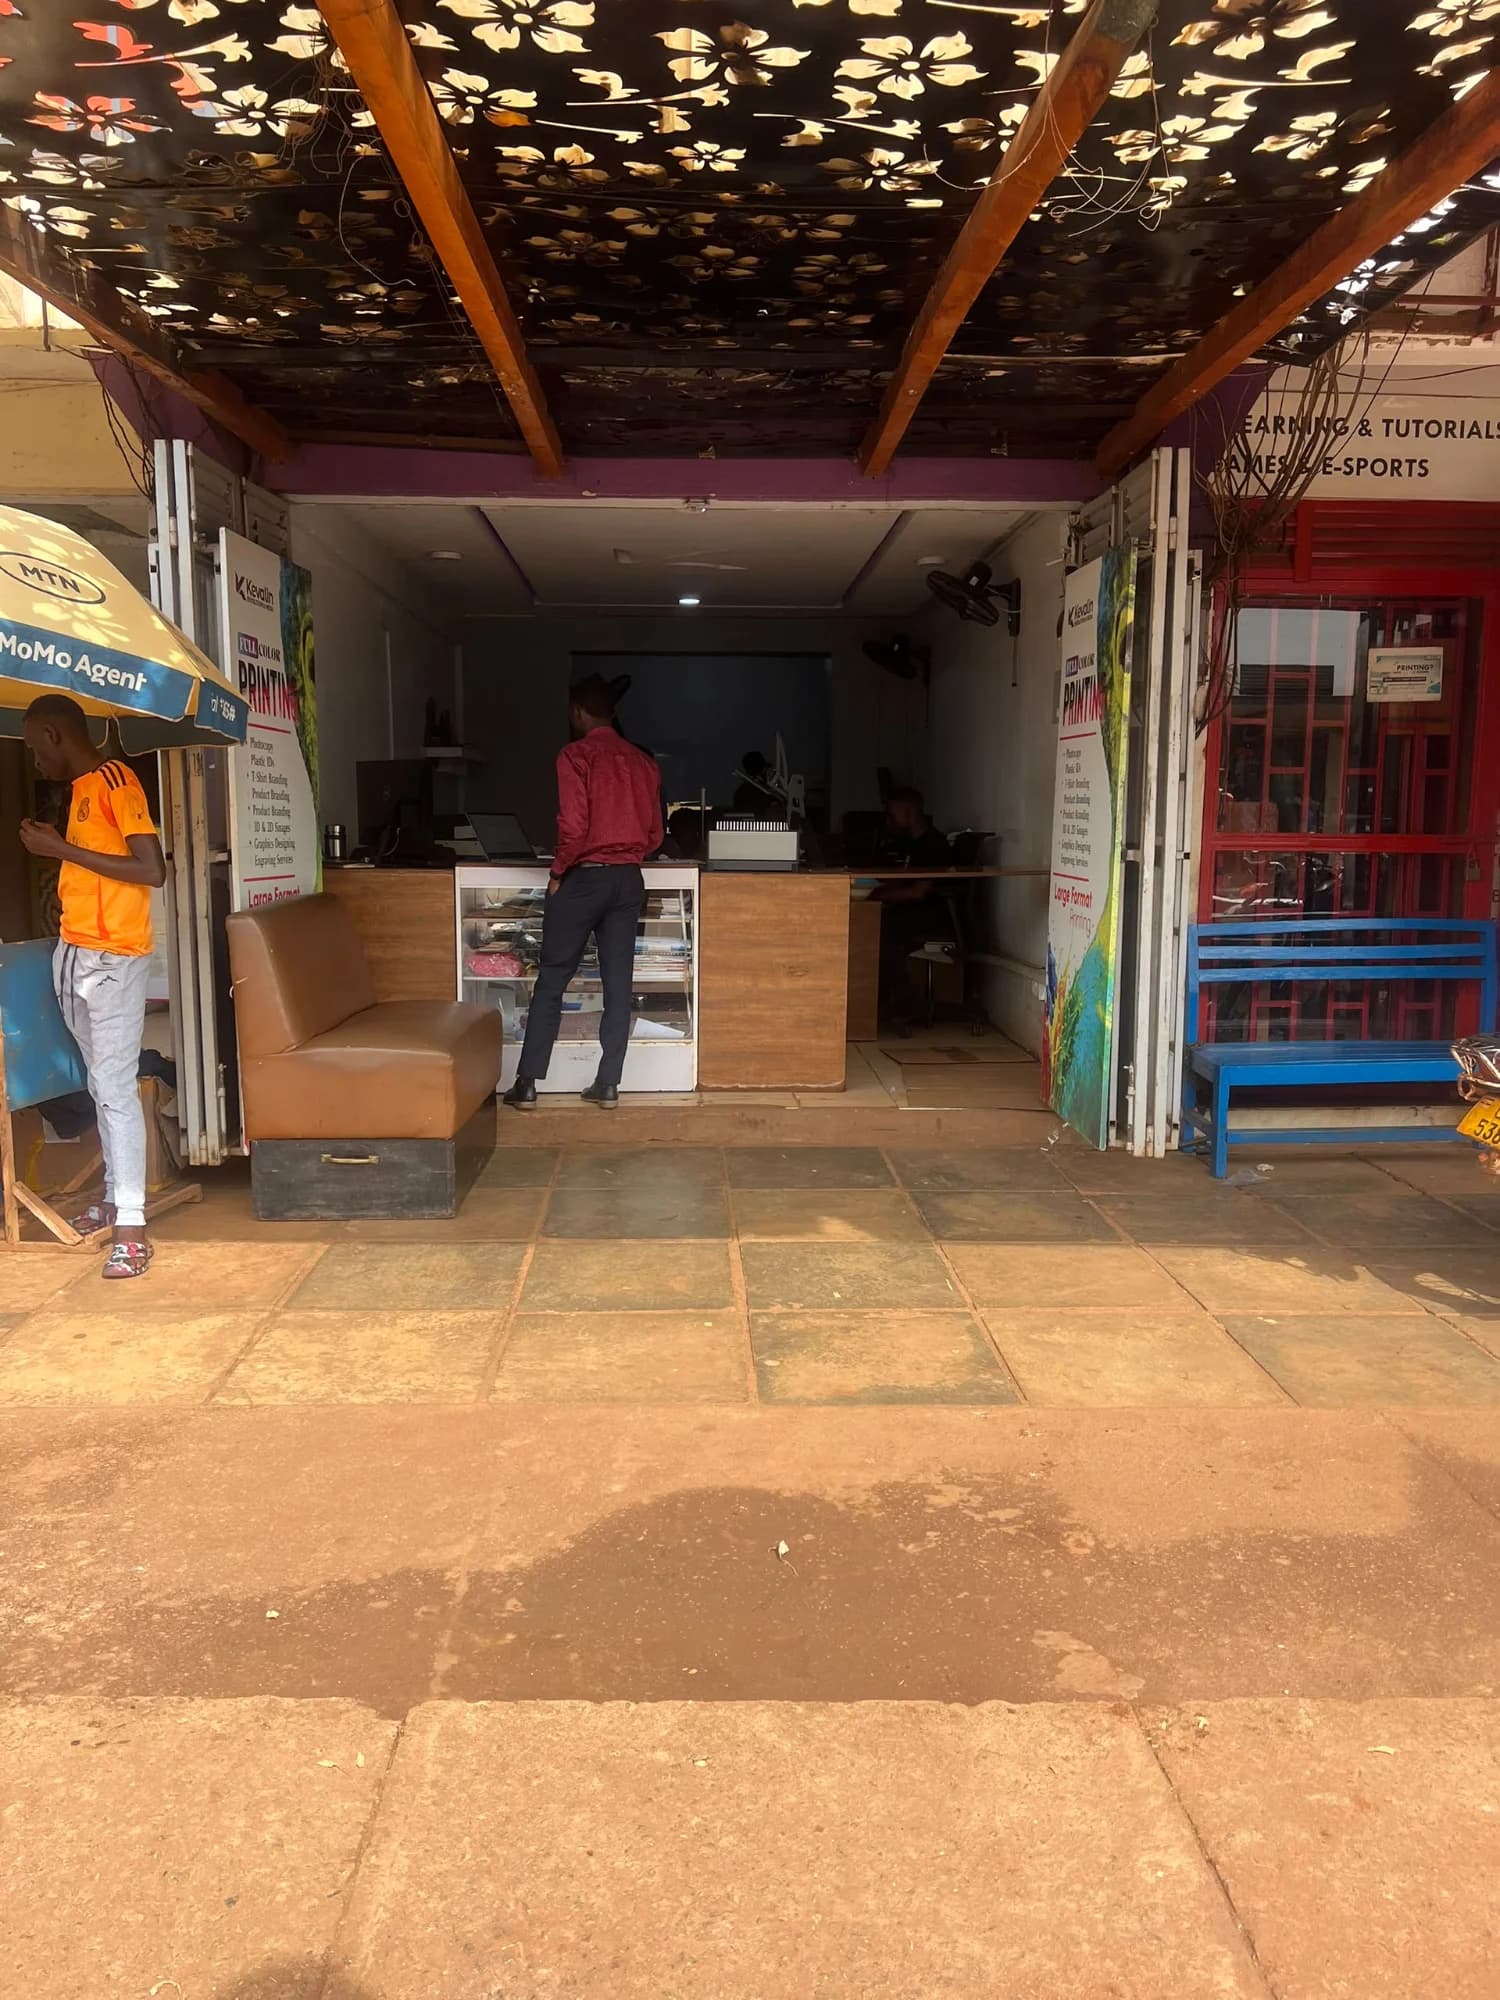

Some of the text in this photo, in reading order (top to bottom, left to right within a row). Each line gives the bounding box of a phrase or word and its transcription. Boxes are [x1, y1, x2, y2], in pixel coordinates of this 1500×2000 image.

[1242, 414, 1350, 436] EARNING
[1357, 418, 1373, 437] &
[1321, 456, 1429, 478] E-SPORTS
[18, 561, 81, 595] MTN
[0, 631, 148, 692] MoMo Agent
[258, 643, 281, 663] COLOR
